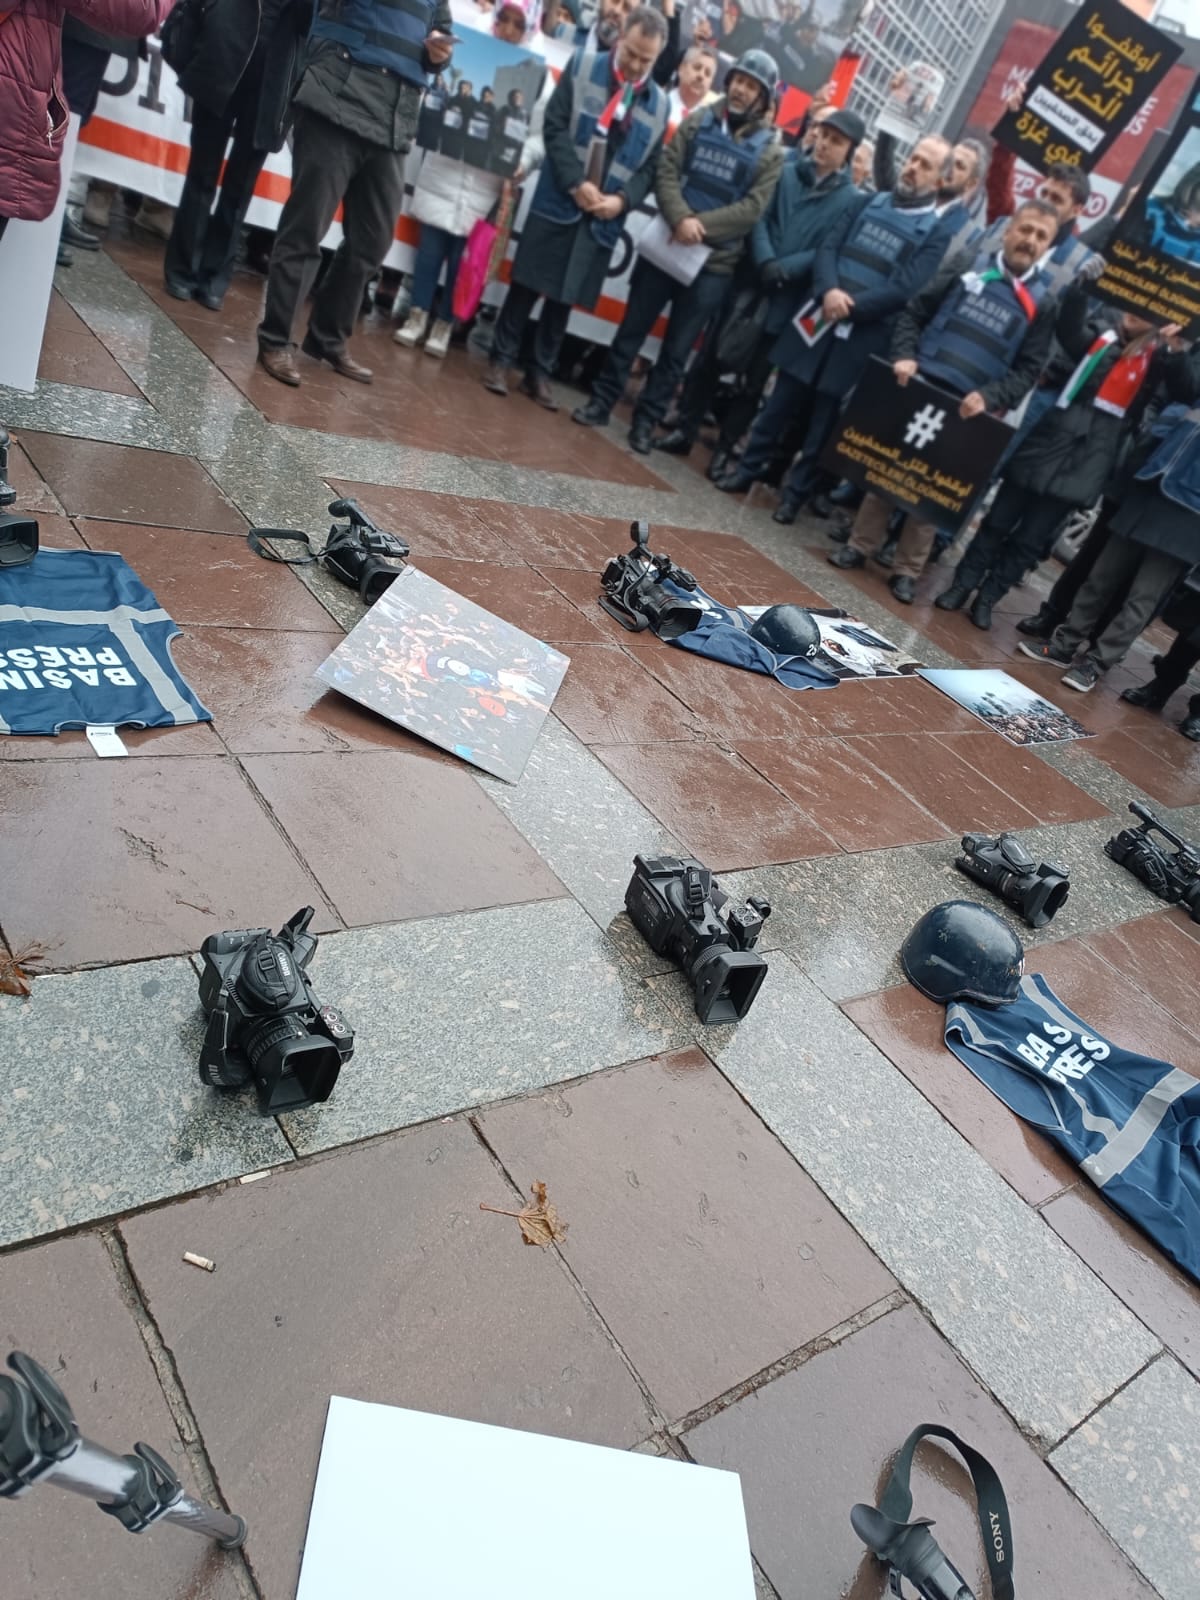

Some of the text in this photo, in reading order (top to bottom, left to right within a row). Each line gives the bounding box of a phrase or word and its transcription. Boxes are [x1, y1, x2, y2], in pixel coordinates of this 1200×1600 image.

[1052, 68, 1124, 121] الحرب
[1015, 111, 1050, 144] غزة
[695, 146, 737, 169] BASIN
[861, 221, 904, 249] BASIN
[959, 305, 1003, 336] PRESS
[966, 293, 1011, 323] BASIN
[0, 645, 123, 669] PRES
[0, 667, 137, 690] BASIN
[1047, 1035, 1111, 1092] PRES
[988, 1511, 1005, 1563] SONY
